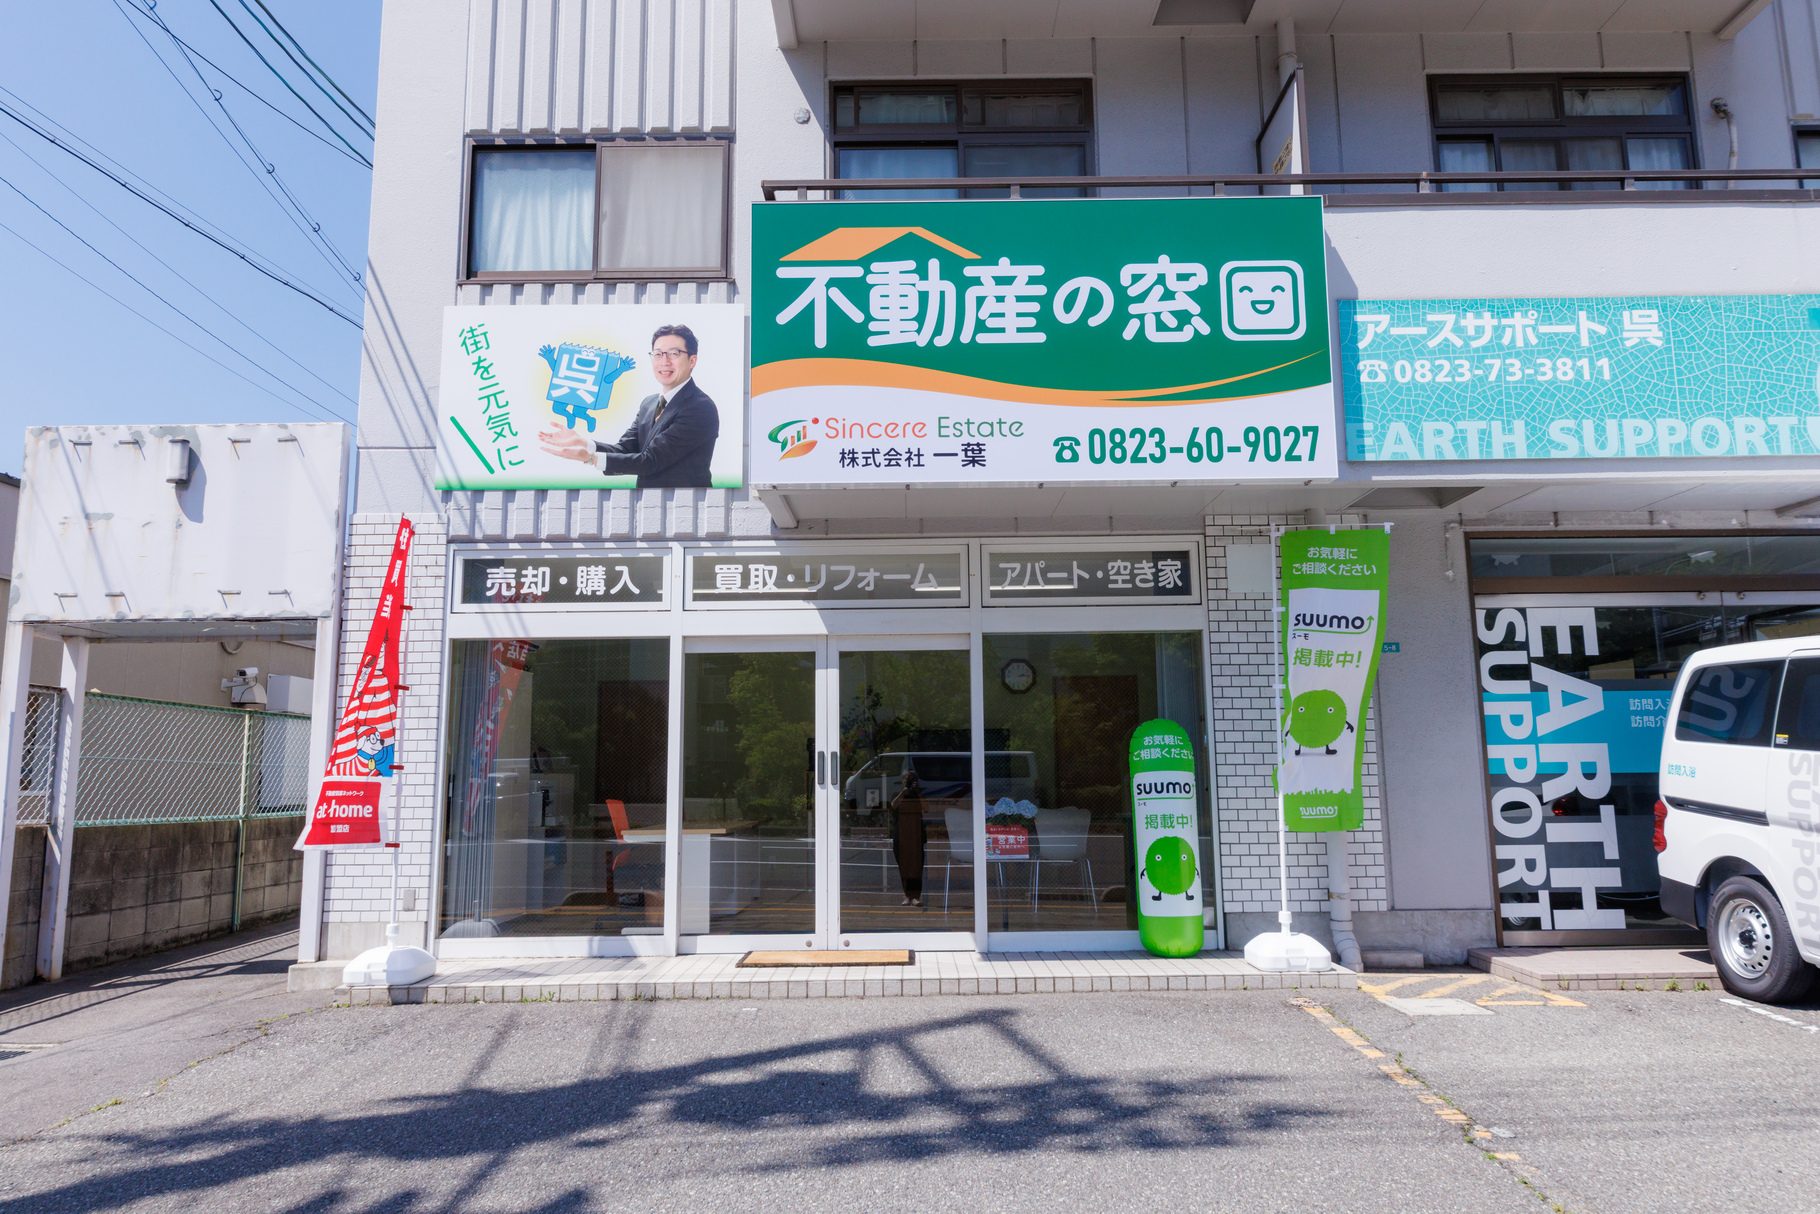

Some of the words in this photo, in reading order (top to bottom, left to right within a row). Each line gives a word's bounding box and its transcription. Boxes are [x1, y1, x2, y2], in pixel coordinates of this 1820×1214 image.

[1354, 310, 1608, 350] アースサポート
[1622, 309, 1664, 348] 呉
[550, 353, 600, 405] 呉
[1394, 357, 1612, 384] 0823-73-3811
[458, 322, 525, 471] 街を元気に
[824, 416, 928, 440] Sincere
[937, 416, 1025, 440] Estate
[1347, 420, 1526, 461] EARTH
[1548, 416, 1799, 459] SUPPORT
[838, 446, 926, 469] 株式会社
[932, 441, 987, 468] 一葉
[1088, 425, 1320, 465] 0823-60-9027
[1292, 561, 1377, 576] ご相談ください
[1307, 546, 1358, 560] お気軽に
[485, 565, 640, 596] 売却・購入
[714, 563, 939, 595] 買取・リフォーム
[999, 559, 1183, 590] アパート・空き家
[1292, 647, 1362, 668] 掲載中!
[1143, 735, 1184, 746] お気軽に
[1475, 607, 1553, 930] SUPPORT
[1525, 607, 1627, 930] EARTH
[1667, 763, 1697, 778] 訪問入浴
[997, 835, 1026, 845] 営業中
